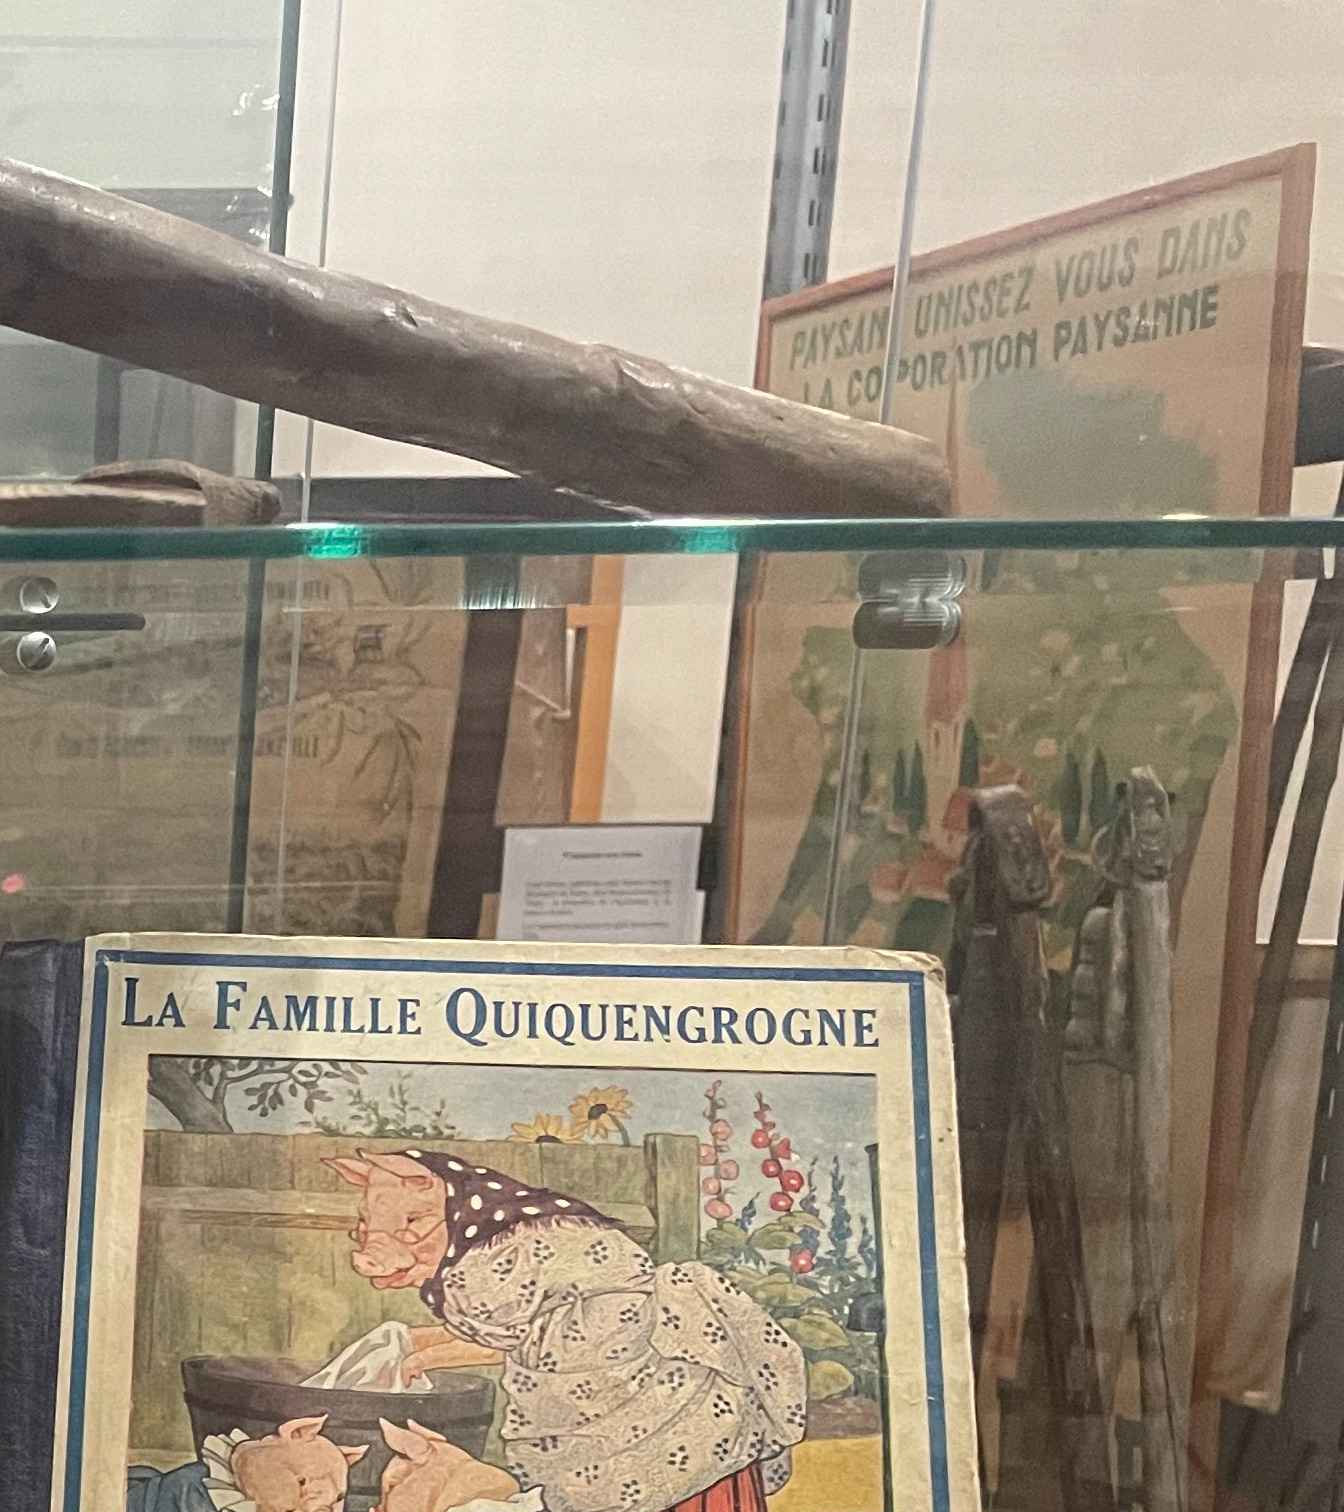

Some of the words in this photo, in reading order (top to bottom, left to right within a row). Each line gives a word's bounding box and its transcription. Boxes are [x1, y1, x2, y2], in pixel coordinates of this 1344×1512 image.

[914, 262, 1037, 339] UNISSEZ
[1055, 235, 1139, 303] VOUS
[1158, 208, 1251, 281] DANS
[847, 327, 1038, 407] COPORATION
[1054, 283, 1220, 362] PAYSANNE
[120, 977, 186, 1031] LA
[214, 980, 422, 1037] FAMILLE
[446, 987, 881, 1049] QUIQUENGROGNE
